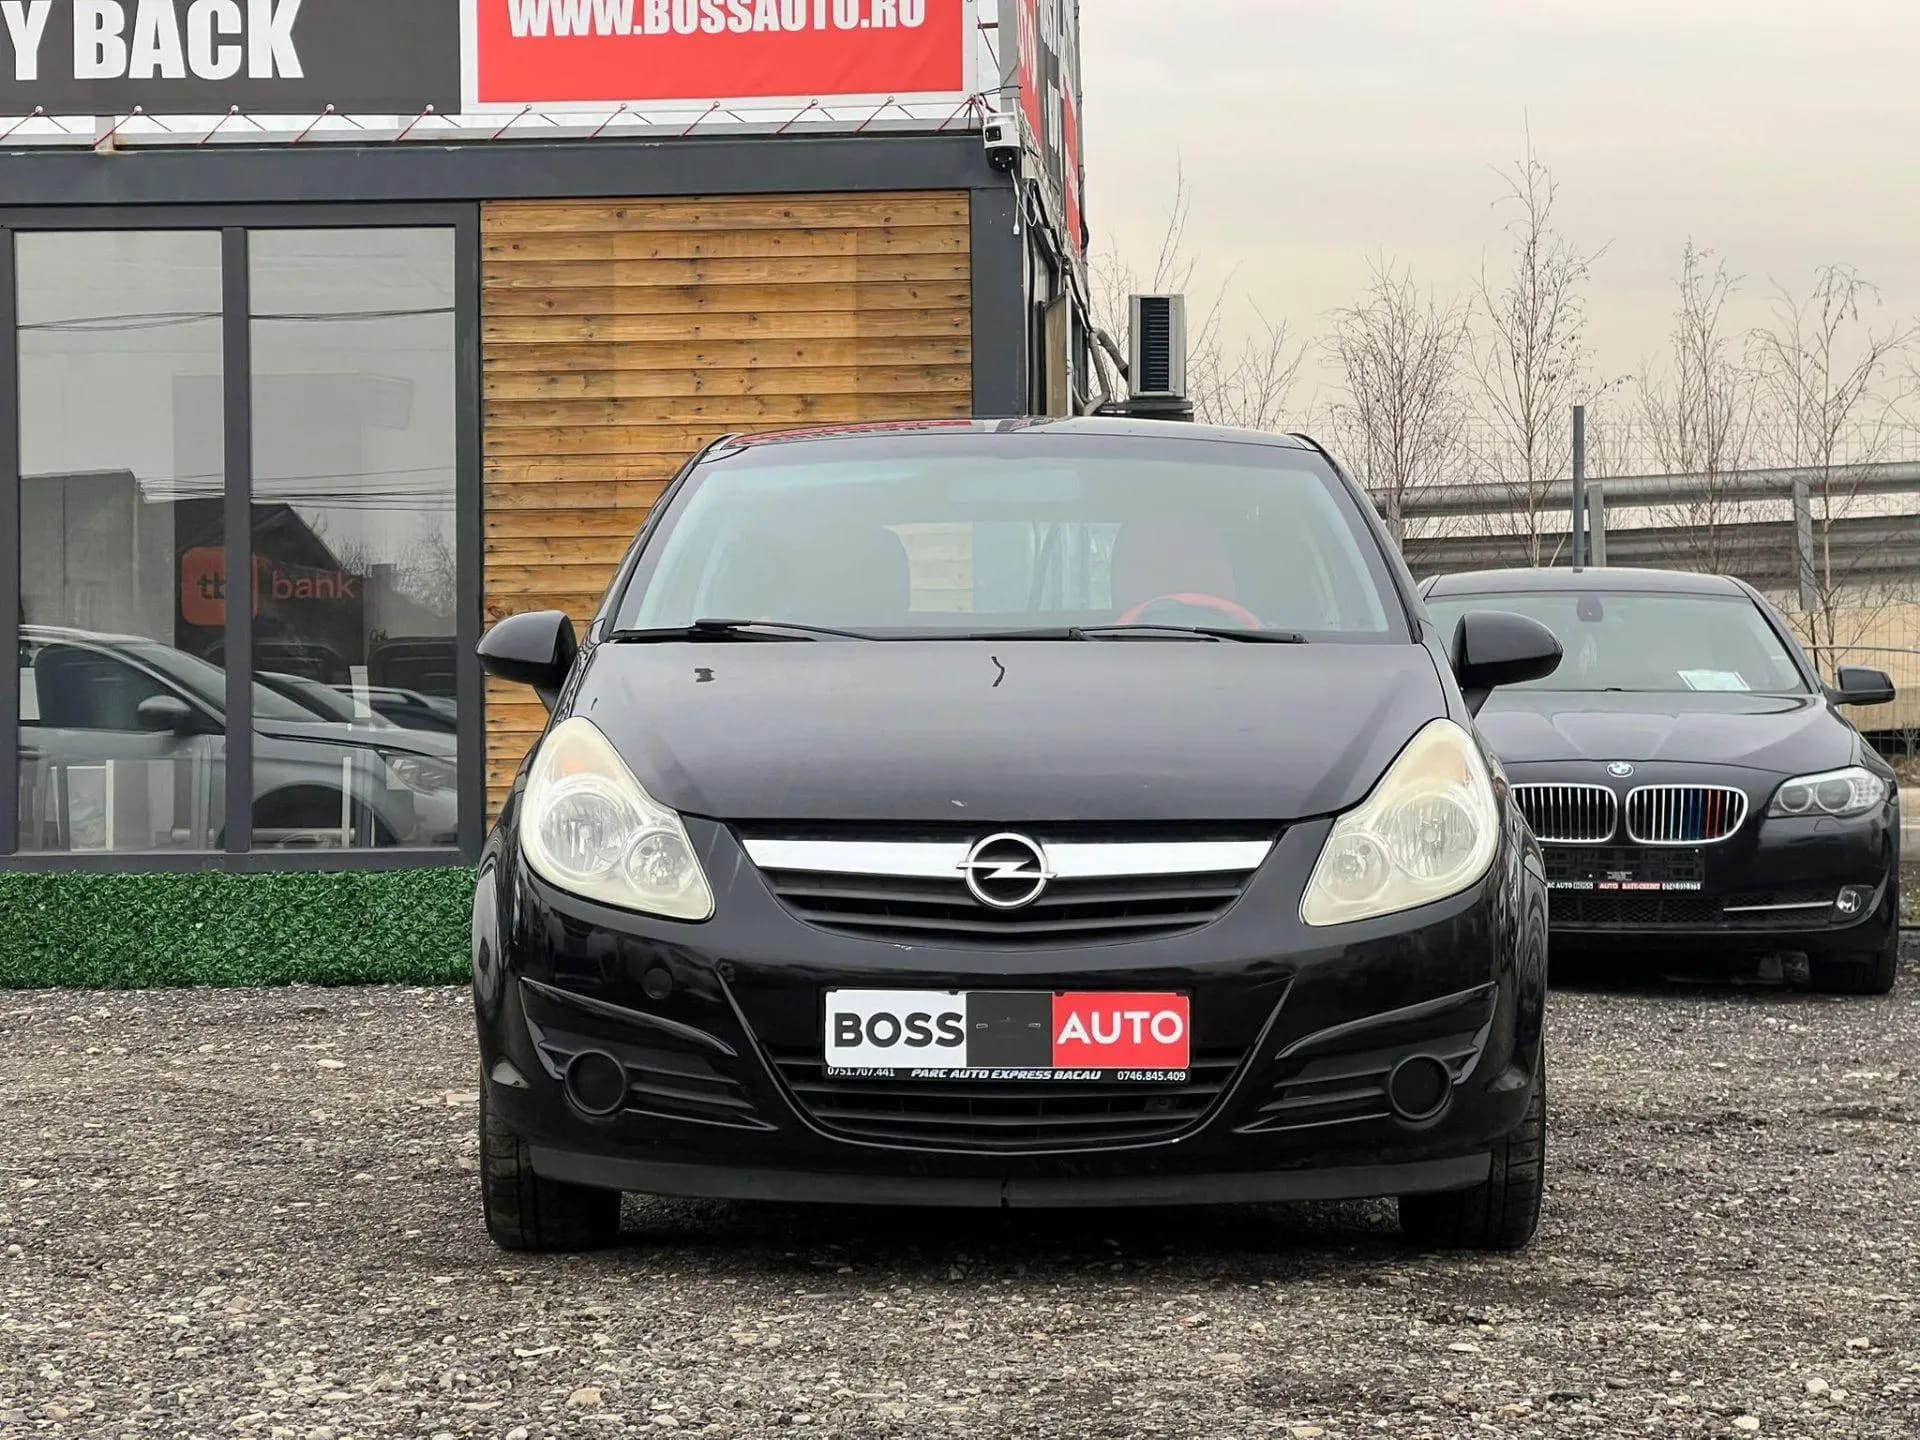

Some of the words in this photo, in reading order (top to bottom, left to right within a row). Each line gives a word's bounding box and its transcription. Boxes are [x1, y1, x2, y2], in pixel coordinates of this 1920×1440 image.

[73, 0, 305, 80] BACK
[272, 570, 355, 600] bank
[834, 1012, 965, 1048] BOSS
[1056, 1010, 1184, 1045] AUTO
[828, 1067, 895, 1077] 0751.707.441
[911, 1069, 948, 1078] PARC
[950, 1069, 989, 1079] AUTO
[991, 1070, 1052, 1080] EXPRESS
[1054, 1070, 1101, 1080] BACAU
[1117, 1070, 1186, 1081] 0746.845.409
